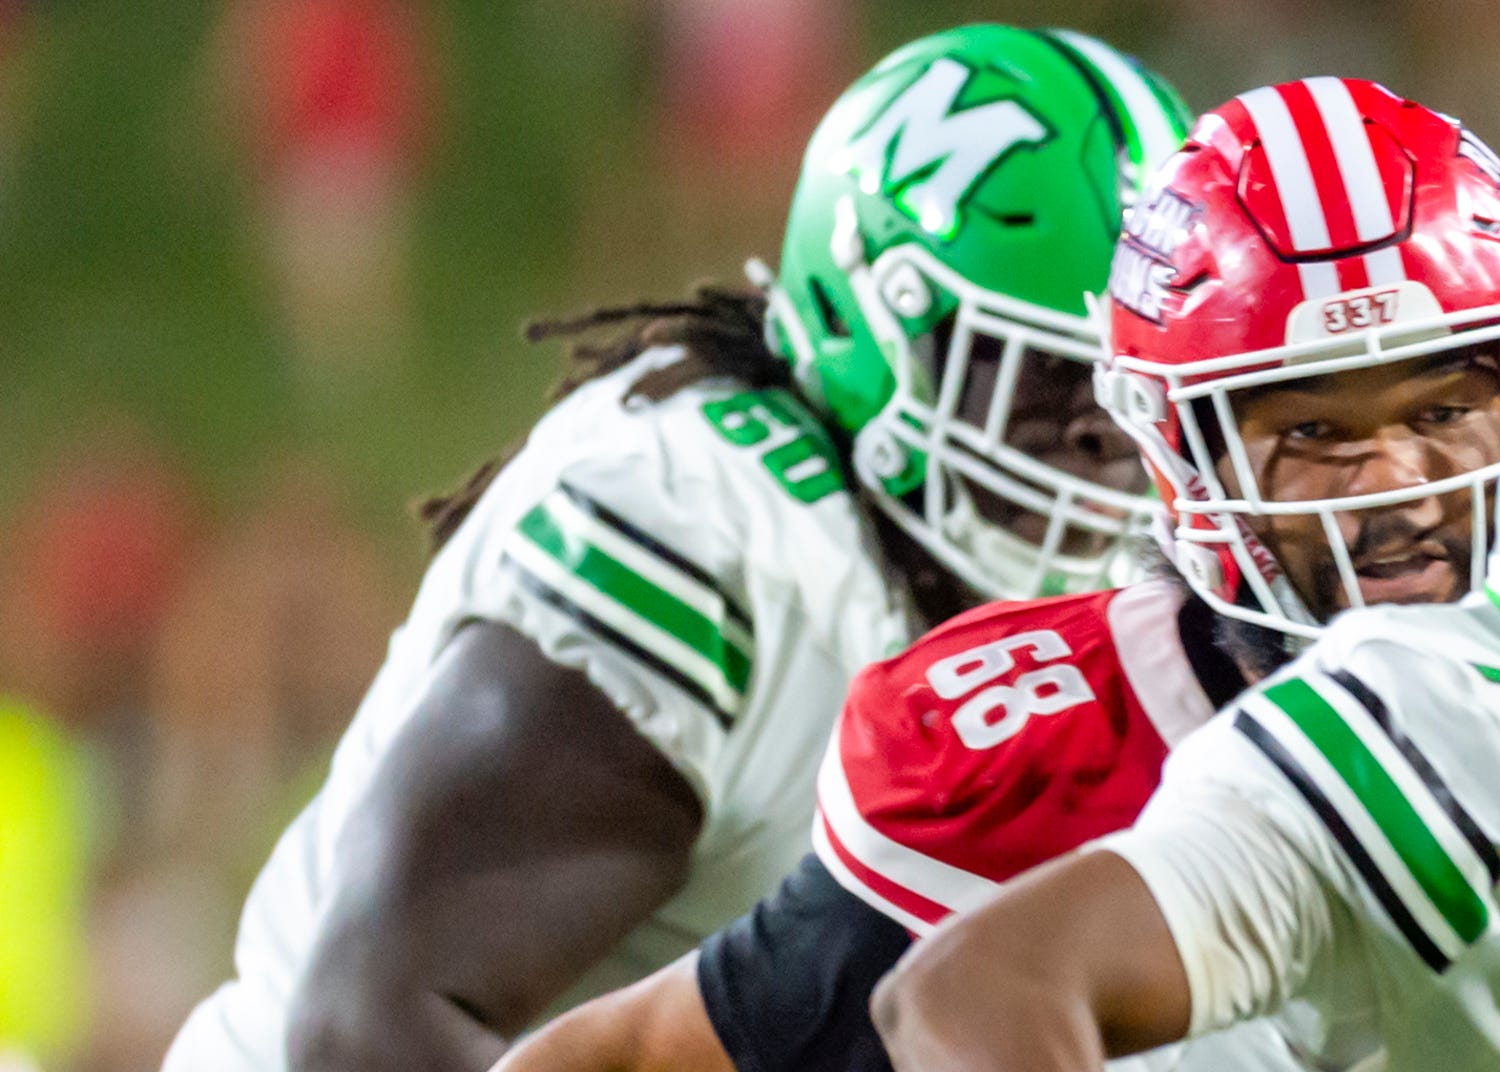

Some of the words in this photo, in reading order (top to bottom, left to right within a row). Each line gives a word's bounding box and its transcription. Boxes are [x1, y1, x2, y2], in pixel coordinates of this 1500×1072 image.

[846, 54, 1060, 240] M
[1323, 289, 1399, 334] 337
[702, 391, 845, 503] 60
[925, 629, 1096, 751] 68
